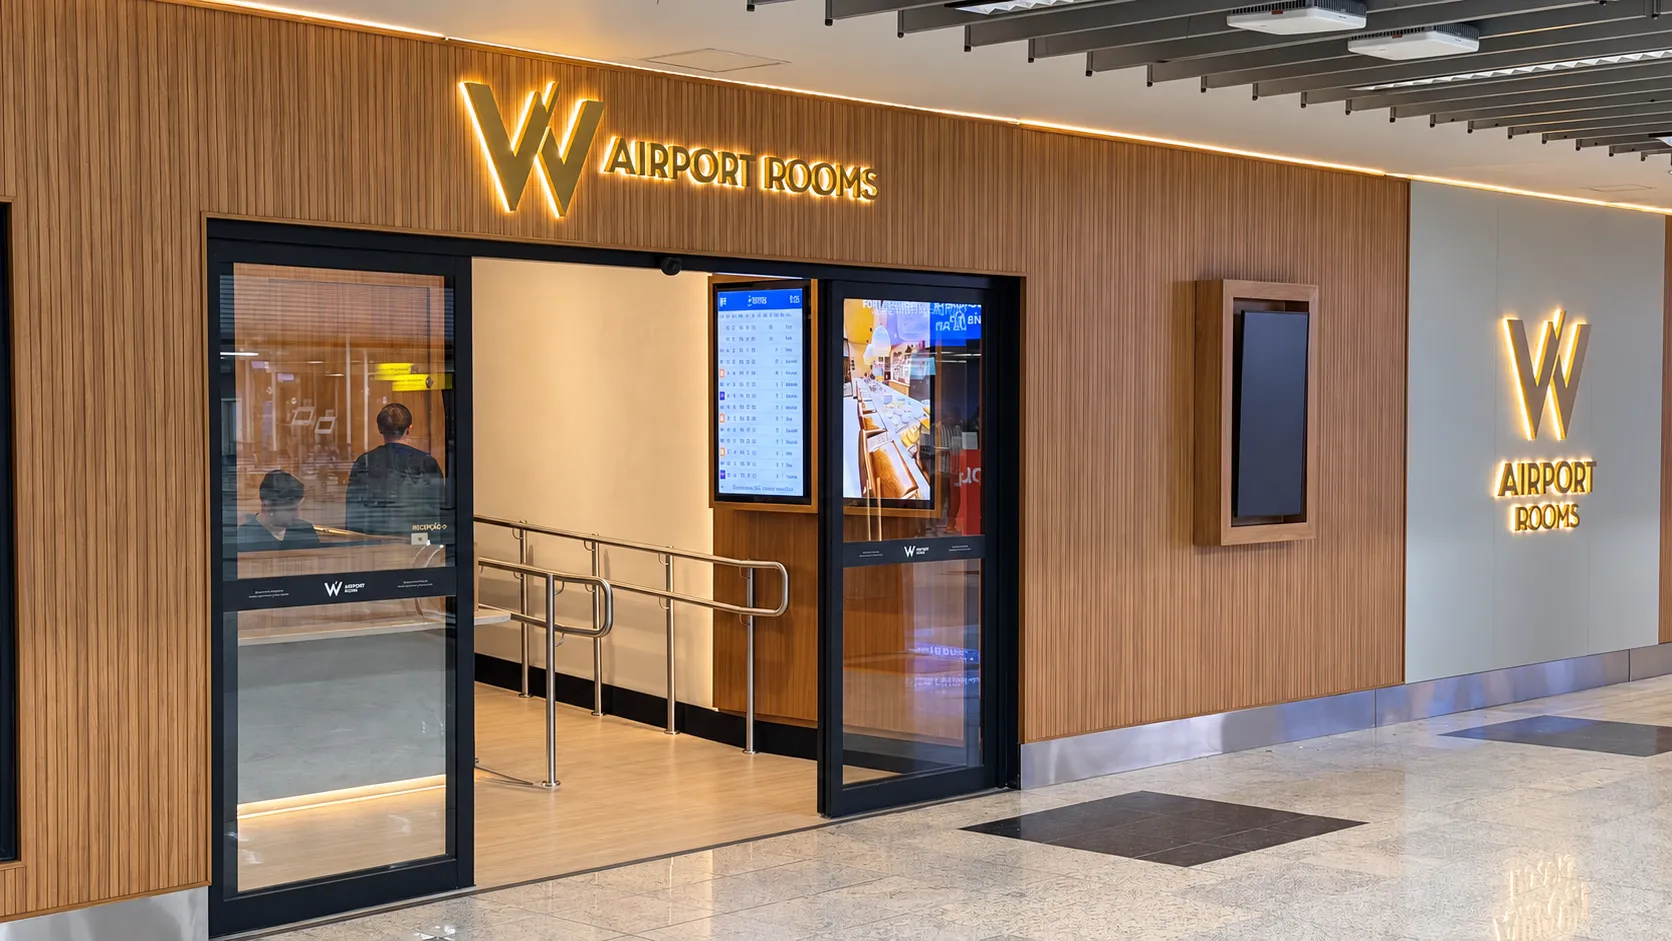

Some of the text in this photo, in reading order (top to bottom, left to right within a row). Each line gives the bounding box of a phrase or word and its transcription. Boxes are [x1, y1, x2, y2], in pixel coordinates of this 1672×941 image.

[460, 80, 604, 218] W
[604, 136, 880, 202] AIRPORT ROOMS
[1502, 308, 1592, 441] W
[1496, 459, 1597, 497] AIRPORT
[1512, 503, 1580, 532] ROOMS
